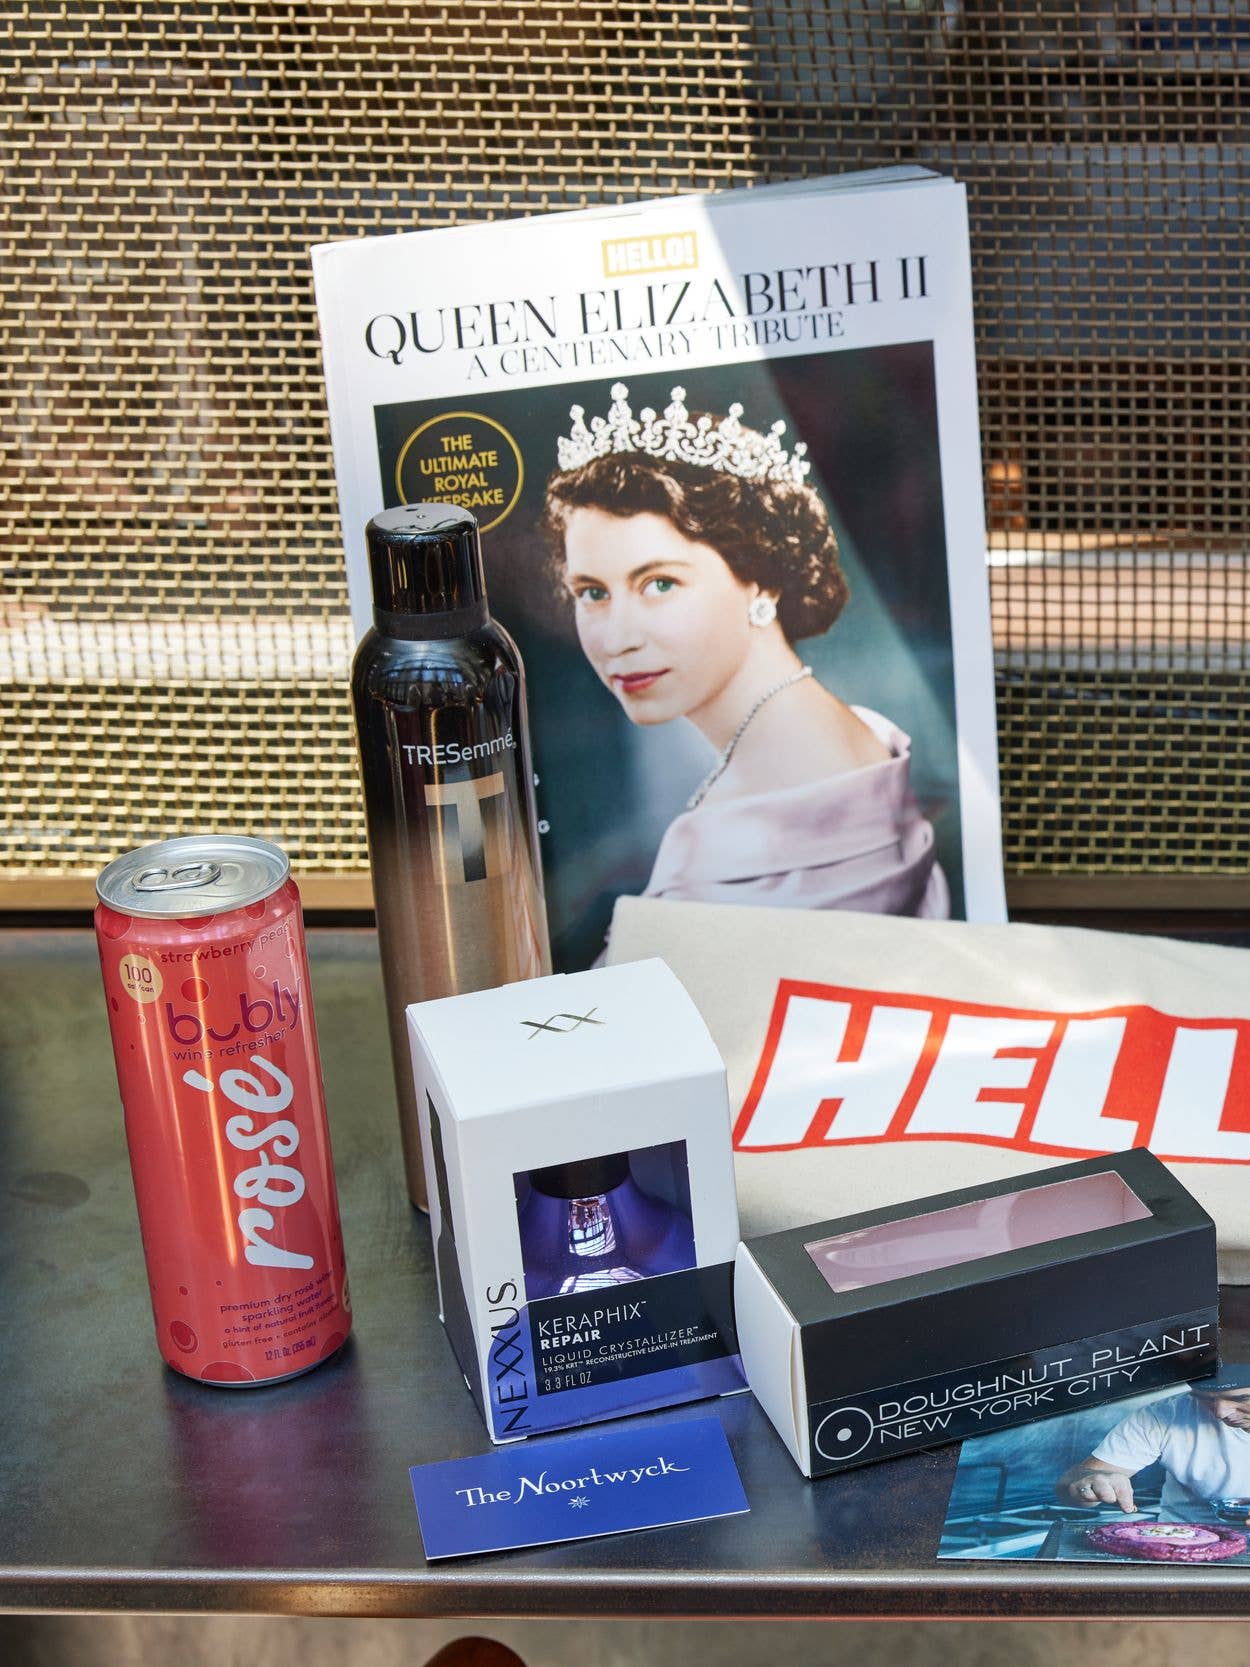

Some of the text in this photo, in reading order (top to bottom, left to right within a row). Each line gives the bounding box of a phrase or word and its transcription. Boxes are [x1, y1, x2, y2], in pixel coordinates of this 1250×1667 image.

[608, 233, 696, 273] HELLO!
[364, 256, 930, 364] QUEEN ELIZABETH II
[467, 311, 846, 379] A CENTENARY TRIBUTE
[441, 434, 473, 452] THE
[420, 451, 498, 475] ULTIMATE
[434, 472, 488, 492] ROYAL
[402, 729, 513, 766] TRESemmé
[161, 915, 297, 963] strawberry peach
[124, 964, 153, 984] 100
[166, 977, 302, 1046] bubly
[173, 1027, 287, 1062] wine refresher
[183, 1055, 314, 1270] rosé
[220, 1299, 271, 1314] premium
[273, 1293, 292, 1305] dry
[233, 1326, 251, 1334] hint
[253, 1323, 262, 1331] of
[265, 1315, 297, 1329] natural
[298, 1307, 315, 1320] fruit
[241, 1303, 294, 1323] sparkling
[297, 1290, 322, 1307] water
[255, 1336, 273, 1345] free
[283, 1321, 317, 1338] contains
[540, 1329, 601, 1350] REPAIR
[486, 1280, 533, 1434] NEXXUS
[542, 1349, 592, 1367] LIQUID
[544, 1363, 565, 1374] 19.3%
[585, 1347, 647, 1366] RECONSTRUCTIVE
[648, 1340, 678, 1353] LEAVE-IN
[680, 1332, 718, 1348] TREATMENT
[545, 1371, 592, 1392] 3.3 FL OZ
[879, 1324, 1210, 1421] DOUGHNUT PLANT
[880, 1366, 1141, 1445] NEW YORK CITY
[456, 1456, 690, 1508] The Noortwyck
